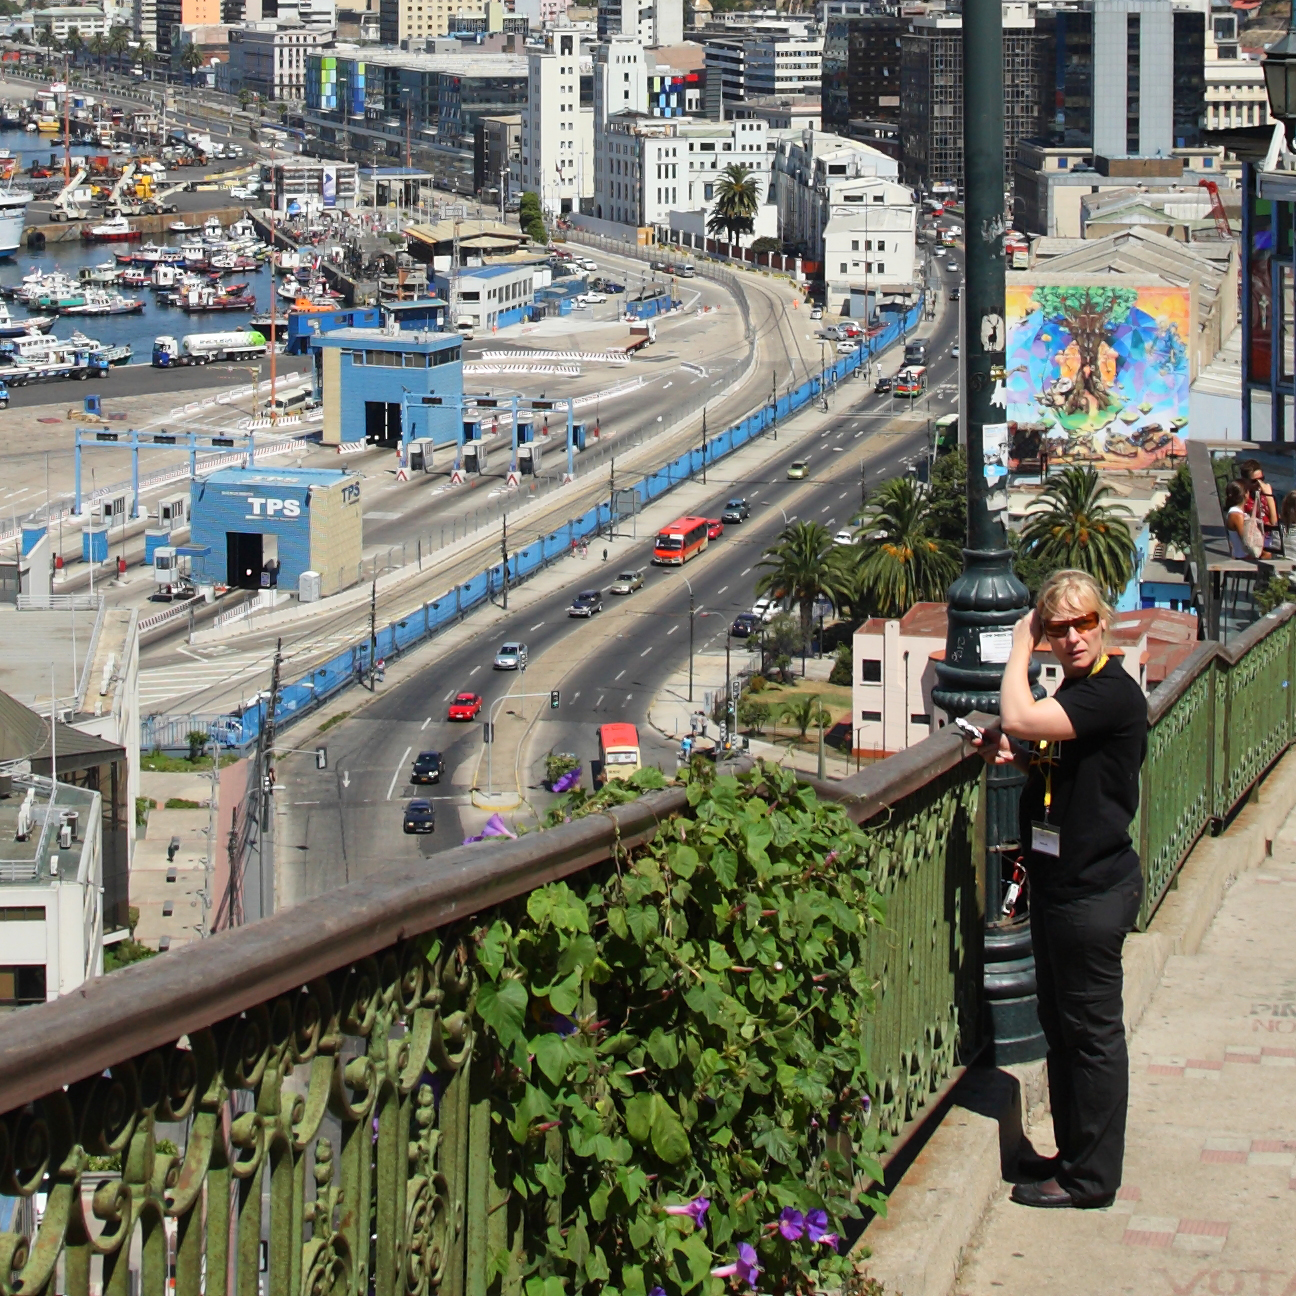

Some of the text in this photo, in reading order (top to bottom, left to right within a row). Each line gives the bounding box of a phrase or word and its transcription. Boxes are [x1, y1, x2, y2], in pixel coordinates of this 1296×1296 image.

[341, 481, 361, 504] TPS
[247, 497, 301, 517] TPS
[1253, 1019, 1296, 1034] NO
